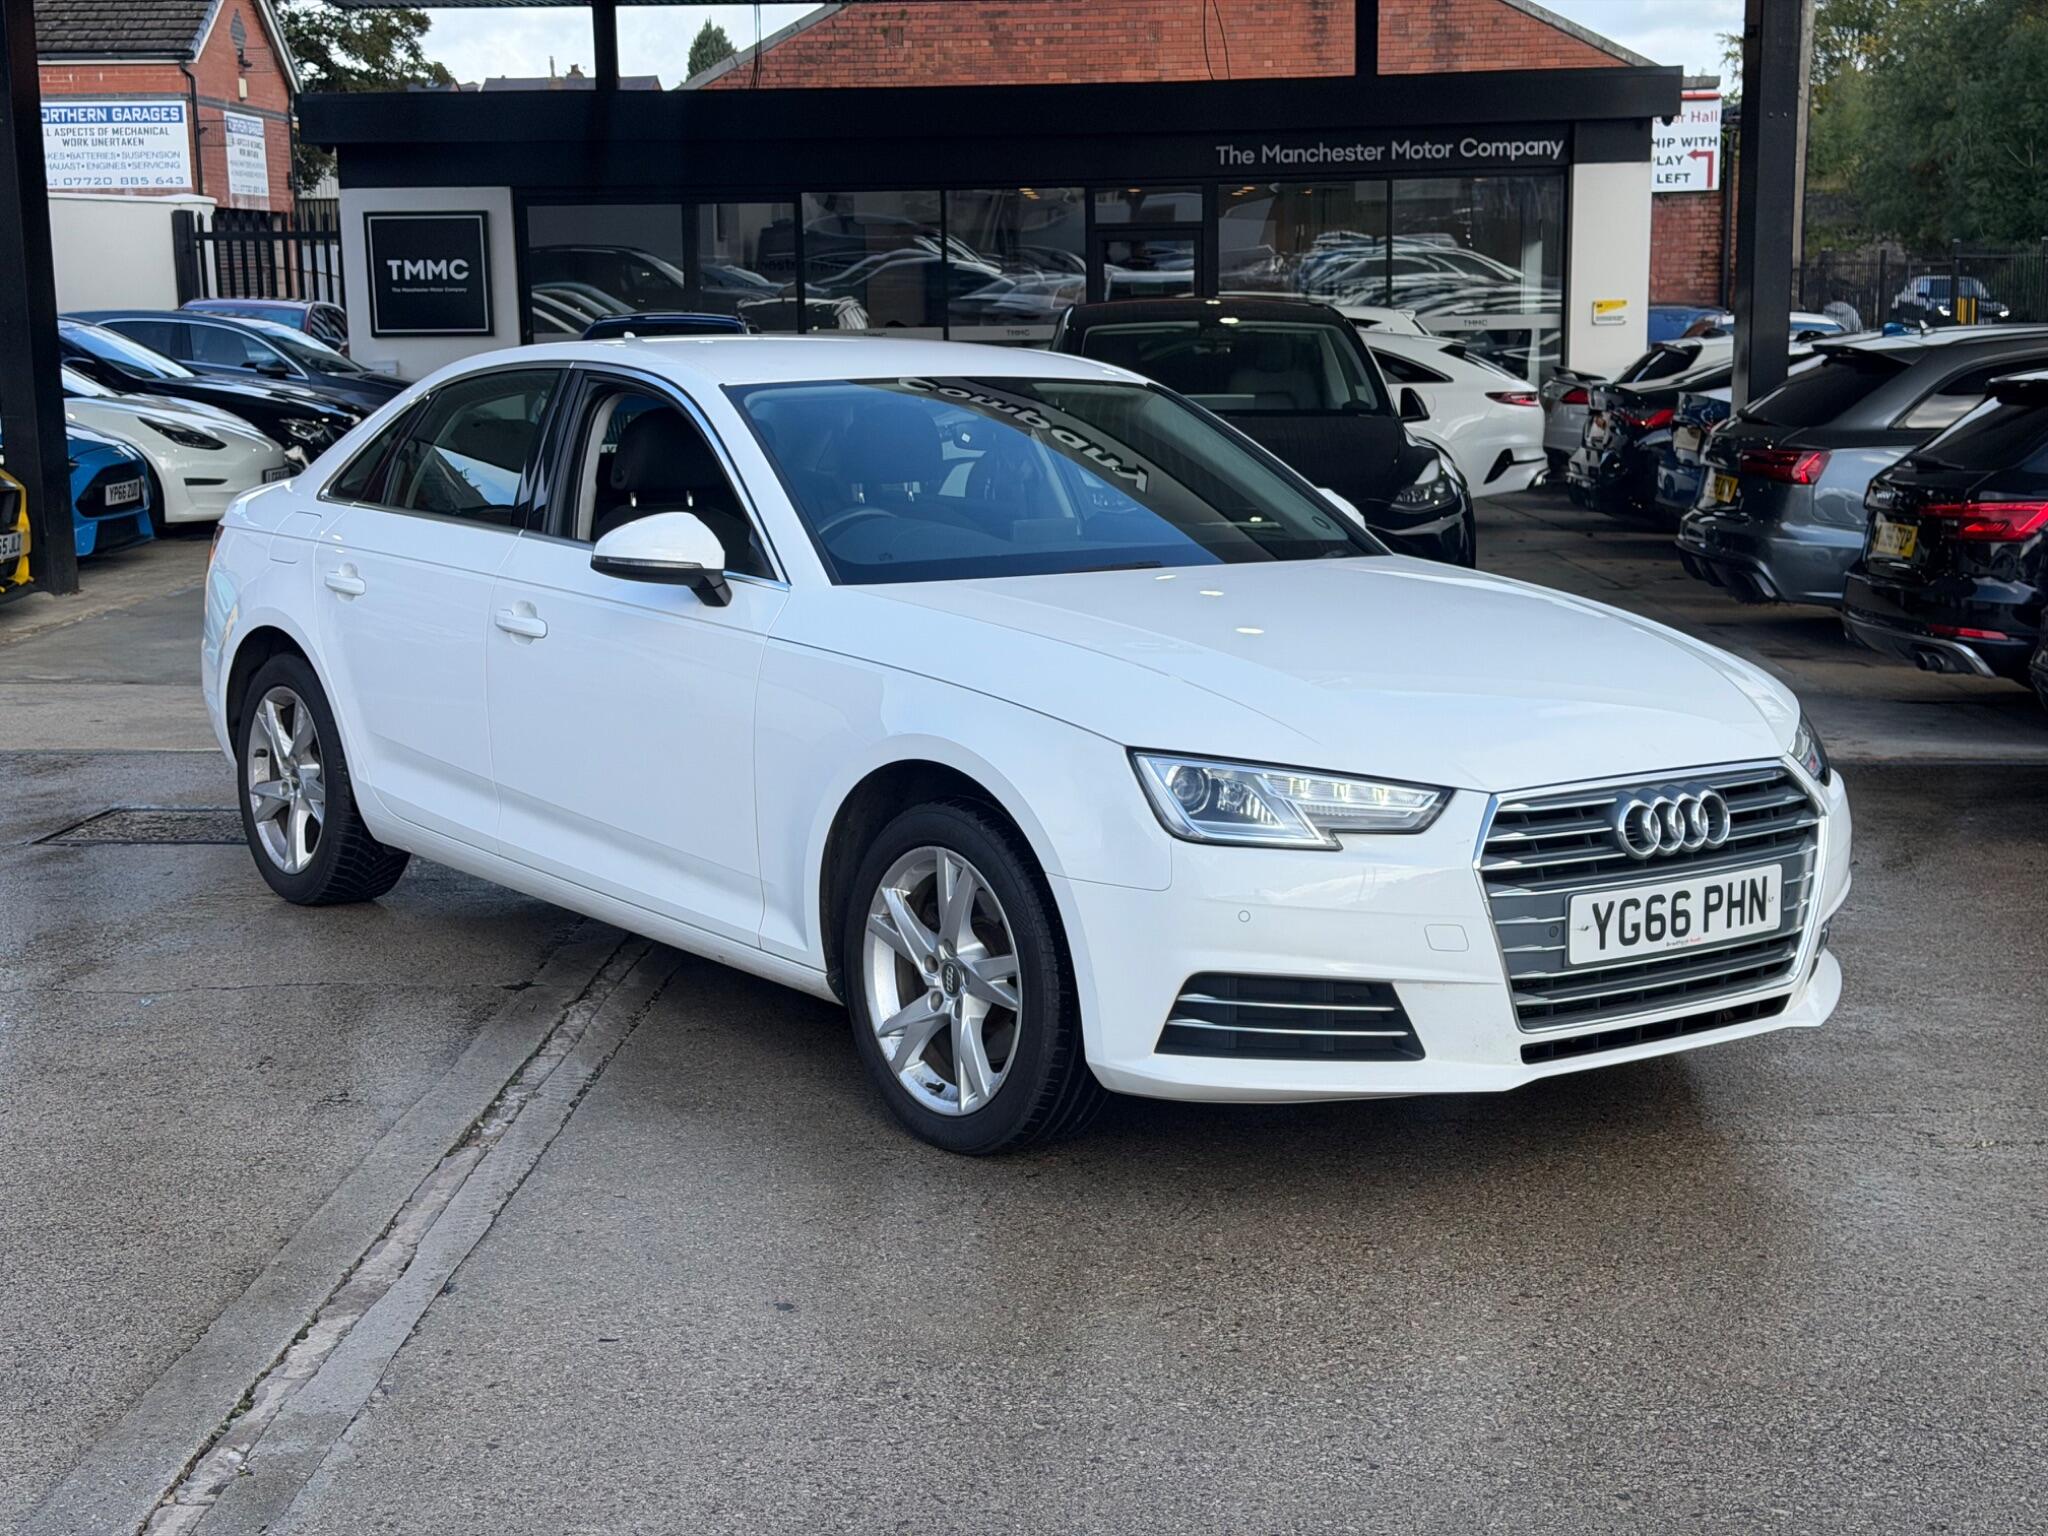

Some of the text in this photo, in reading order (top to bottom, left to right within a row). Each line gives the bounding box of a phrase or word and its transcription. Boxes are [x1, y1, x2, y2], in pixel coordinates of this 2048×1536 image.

[112, 107, 180, 122] GARAGES
[1691, 110, 1718, 122] Hall
[54, 127, 95, 137] ASPECTS
[98, 127, 110, 137] OF
[112, 126, 170, 136] MECHANICAL
[62, 137, 145, 147] WORK UNERTAKEN
[1681, 136, 1718, 147] WITH
[121, 150, 181, 159] SUSPENSION
[1216, 138, 1564, 165] The Manchester Motor Company
[132, 161, 181, 169] SERVICING
[1653, 155, 1684, 166] LAY
[63, 176, 112, 186] 07720
[155, 176, 184, 185] 643
[1656, 173, 1691, 184] LEFT
[386, 259, 470, 280] TMMC
[1592, 875, 1768, 950] YG66 PHN
